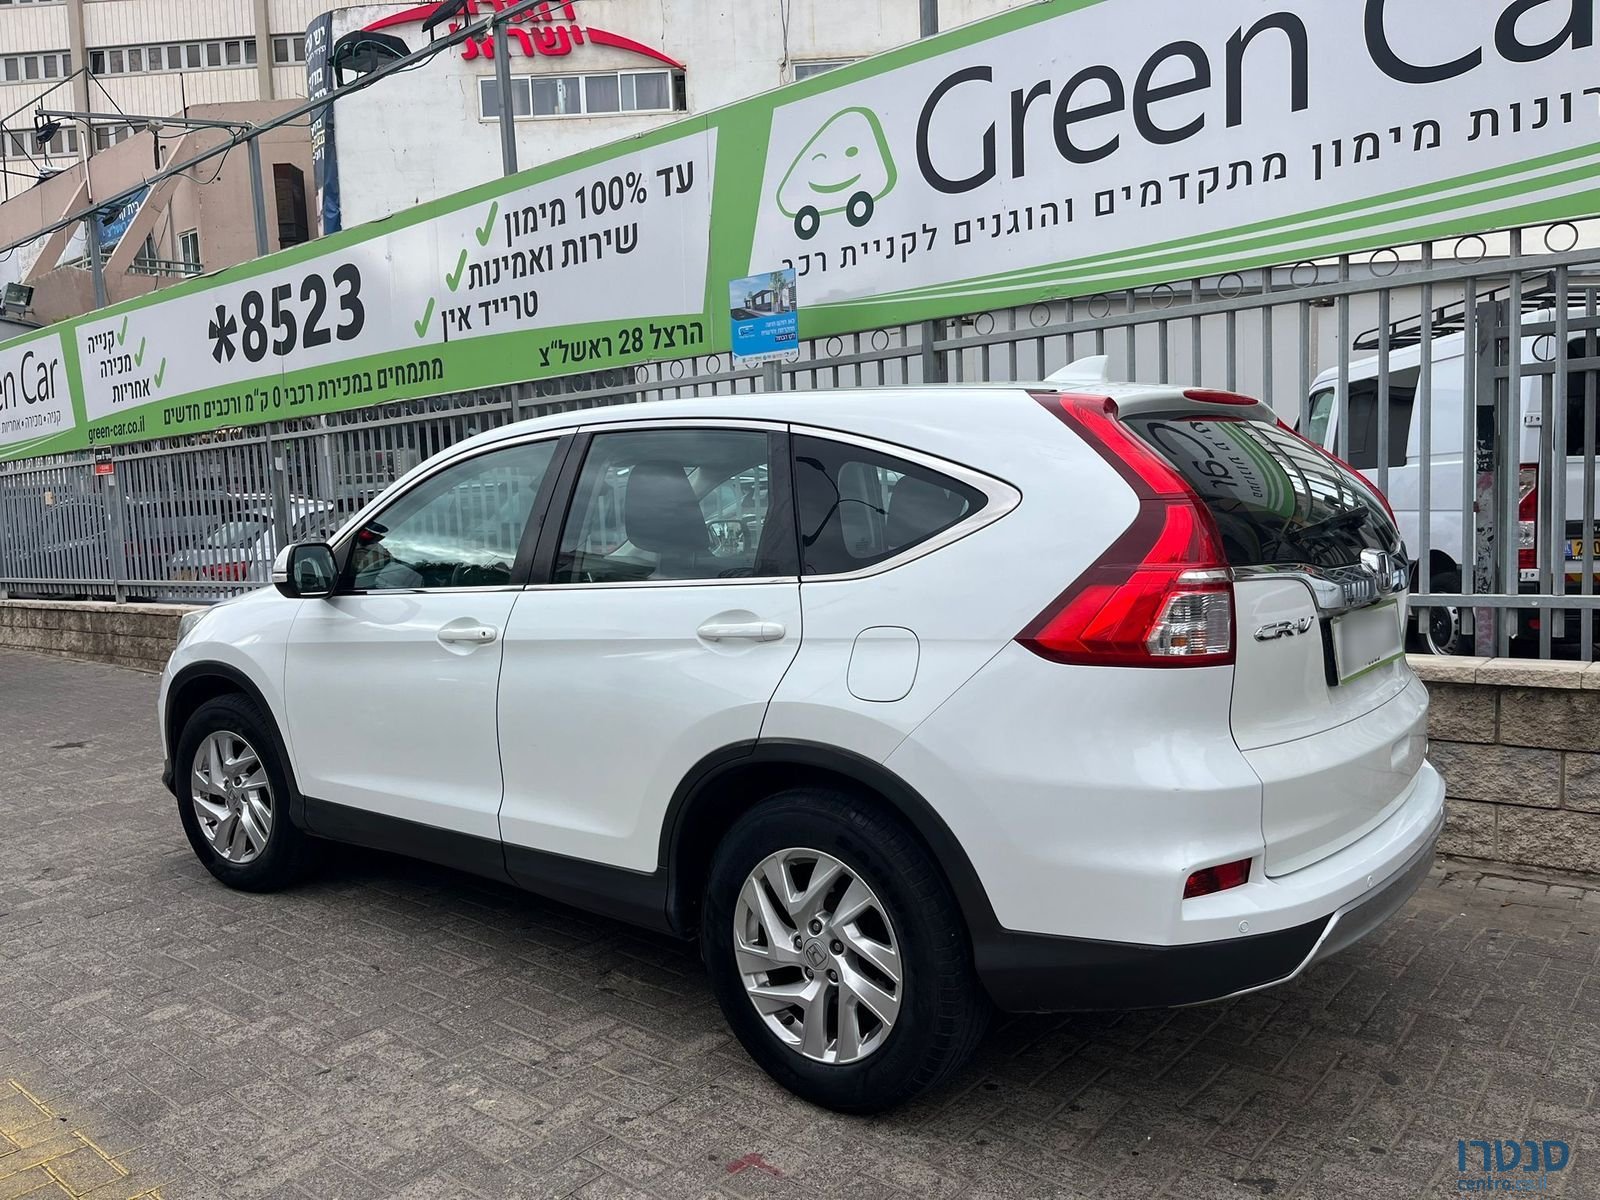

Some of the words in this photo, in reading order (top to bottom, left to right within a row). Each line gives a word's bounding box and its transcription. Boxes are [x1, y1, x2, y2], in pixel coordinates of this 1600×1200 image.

[916, 12, 1309, 194] Green
[1312, 118, 1441, 180] מימון
[575, 172, 648, 219] 100%
[657, 161, 694, 197] עד
[1095, 152, 1288, 216] מתקדמים
[505, 198, 566, 247] מימון
[954, 197, 1074, 246] והוגנים
[561, 222, 638, 268] שירות
[839, 223, 938, 269] לקניית
[468, 244, 554, 290] ואמינות
[441, 304, 472, 343] אין
[478, 290, 539, 326] טרייד
[87, 330, 115, 354] קנייה
[618, 327, 644, 356] 28
[649, 320, 704, 350] הרצל
[20, 350, 58, 405] Car
[100, 354, 132, 378] מכירה
[377, 358, 443, 390] מתמחים
[112, 378, 151, 403] אחריות
[284, 383, 314, 406] רכבי
[317, 371, 373, 401] במכירת
[163, 403, 201, 425] חדשים
[204, 396, 241, 418] ורכבים
[88, 415, 145, 444] green-car.co.il
